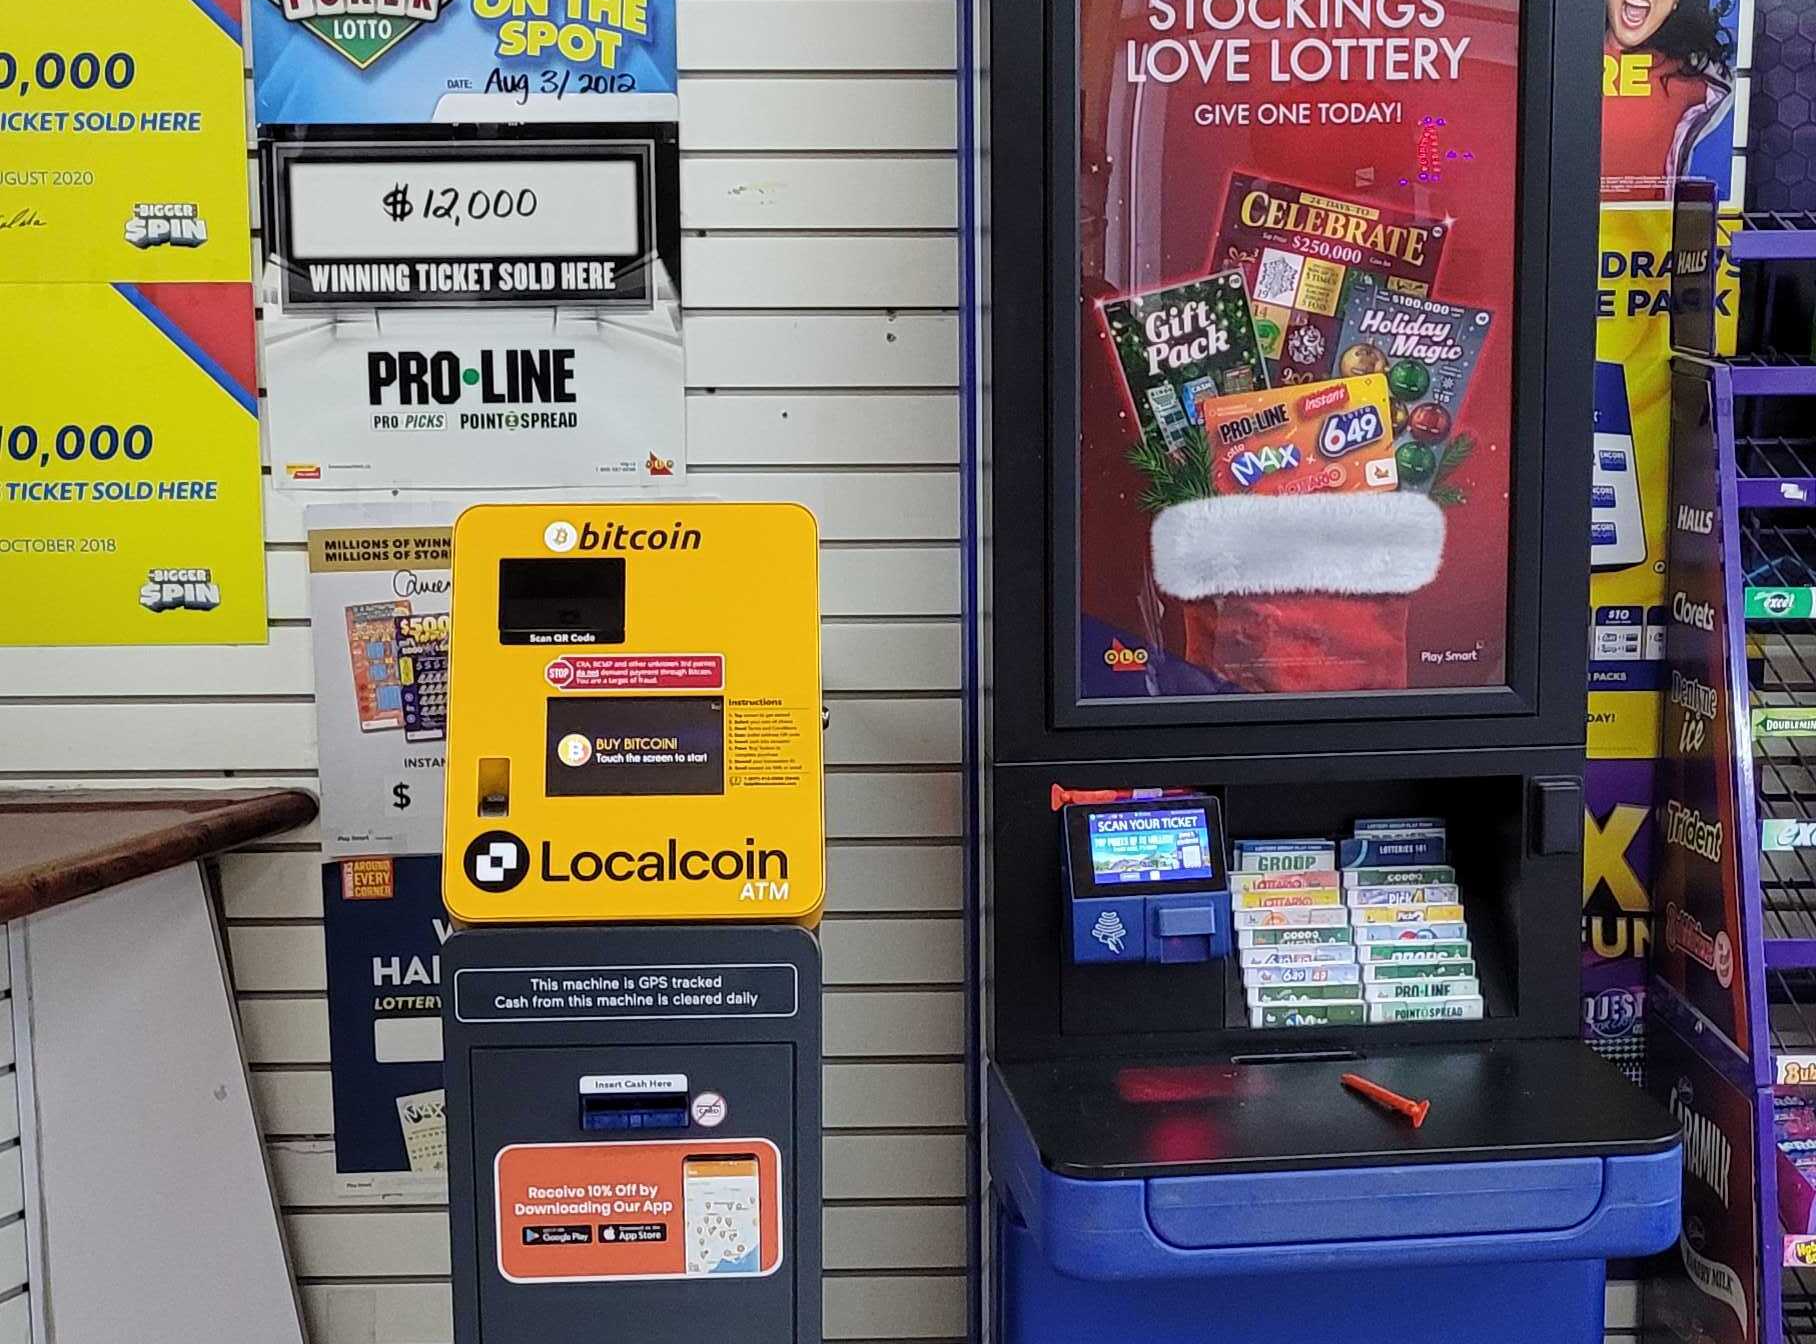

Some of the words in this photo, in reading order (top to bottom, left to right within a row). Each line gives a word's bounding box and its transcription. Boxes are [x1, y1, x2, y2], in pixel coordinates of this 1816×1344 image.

[333, 18, 392, 39] LOTTO
[498, 21, 622, 69] SPOT
[1126, 38, 1250, 85] LOVE
[1271, 36, 1471, 83] LOTTERY
[447, 79, 473, 89] DATE:
[484, 67, 530, 105] Aug
[578, 74, 637, 95] 2012
[73, 112, 135, 131] SOLD
[141, 112, 201, 131] HERE
[1194, 103, 1250, 127] GIVE
[1258, 103, 1312, 127] ONE
[1318, 102, 1403, 126] TODAY!
[53, 171, 94, 185] 2020
[140, 204, 194, 217] BIGGER
[1241, 191, 1428, 267] CELEBRATE
[1291, 235, 1362, 265] $250,000
[1677, 249, 1708, 275] HALLS
[309, 264, 410, 292] WINNING
[416, 263, 493, 292] TICKET
[498, 262, 555, 291] SOLD
[561, 262, 616, 290] HERE
[1145, 300, 1212, 344] Gift
[1360, 310, 1452, 342] Holiday
[1146, 324, 1231, 377] Pack
[1389, 335, 1463, 364] Magic
[373, 414, 399, 429] PRO
[404, 414, 444, 429] PICKS
[0, 424, 152, 468] 0,000
[1230, 443, 1299, 487] MAX
[6, 482, 89, 501] TICKET
[92, 481, 152, 500] SOLD
[158, 481, 217, 500] HERE
[1677, 505, 1713, 534] HALLS
[325, 540, 389, 551] MILLIONS
[393, 539, 411, 549] OF
[578, 522, 701, 550] bitcoin
[0, 539, 75, 553] OCTOBER
[80, 539, 117, 552] 2018
[325, 551, 389, 561] MILLIONS
[393, 550, 411, 560] OF
[154, 569, 208, 582] BIGGER
[1763, 592, 1795, 609] excel
[1673, 592, 1714, 632] Clorets
[530, 634, 552, 643] Scan
[554, 634, 568, 643] QR
[571, 633, 595, 643] Code
[1421, 650, 1443, 664] Play
[1445, 649, 1478, 662] Smart
[549, 667, 569, 679] STOP
[1593, 672, 1627, 682] PACKS
[728, 699, 782, 707] Instructions
[1672, 670, 1717, 720] Dentyne
[1680, 714, 1705, 753] ice
[596, 738, 621, 751] BUY
[596, 753, 624, 763] Touch
[626, 753, 641, 763] the
[643, 754, 673, 763] screen
[675, 753, 684, 762] to
[687, 753, 708, 762] start
[392, 781, 411, 811] $
[1097, 819, 1128, 833] SCAN
[1129, 817, 1160, 830] YOUR
[1161, 815, 1198, 828] TICKET
[1667, 800, 1724, 863] Trident
[541, 838, 789, 882] Localcoin
[1258, 855, 1317, 872] GROUP
[355, 872, 390, 885] EVERY
[739, 881, 790, 901] ATM
[530, 978, 558, 991] This
[563, 977, 619, 990] machine
[624, 976, 634, 989] is
[638, 976, 668, 989] GPS
[672, 975, 722, 989] tracked
[494, 995, 529, 1009] Cash
[532, 994, 564, 1008] from
[568, 994, 592, 1007] this
[597, 993, 653, 1007] machine
[658, 993, 669, 1006] is
[673, 992, 722, 1006] cleared
[726, 991, 758, 1007] daily
[595, 1079, 622, 1089] Insert
[625, 1079, 648, 1089] Cash
[650, 1079, 672, 1089] Here
[528, 1186, 585, 1199] Receive
[588, 1185, 612, 1197] 10%
[615, 1184, 637, 1197] Off
[639, 1184, 658, 1199] by
[515, 1202, 611, 1217] Downloading
[613, 1201, 641, 1214] Our
[643, 1200, 673, 1216] App
[542, 1232, 571, 1243] Google
[572, 1231, 589, 1242] Play
[619, 1232, 637, 1242] App
[639, 1231, 661, 1241] Store
